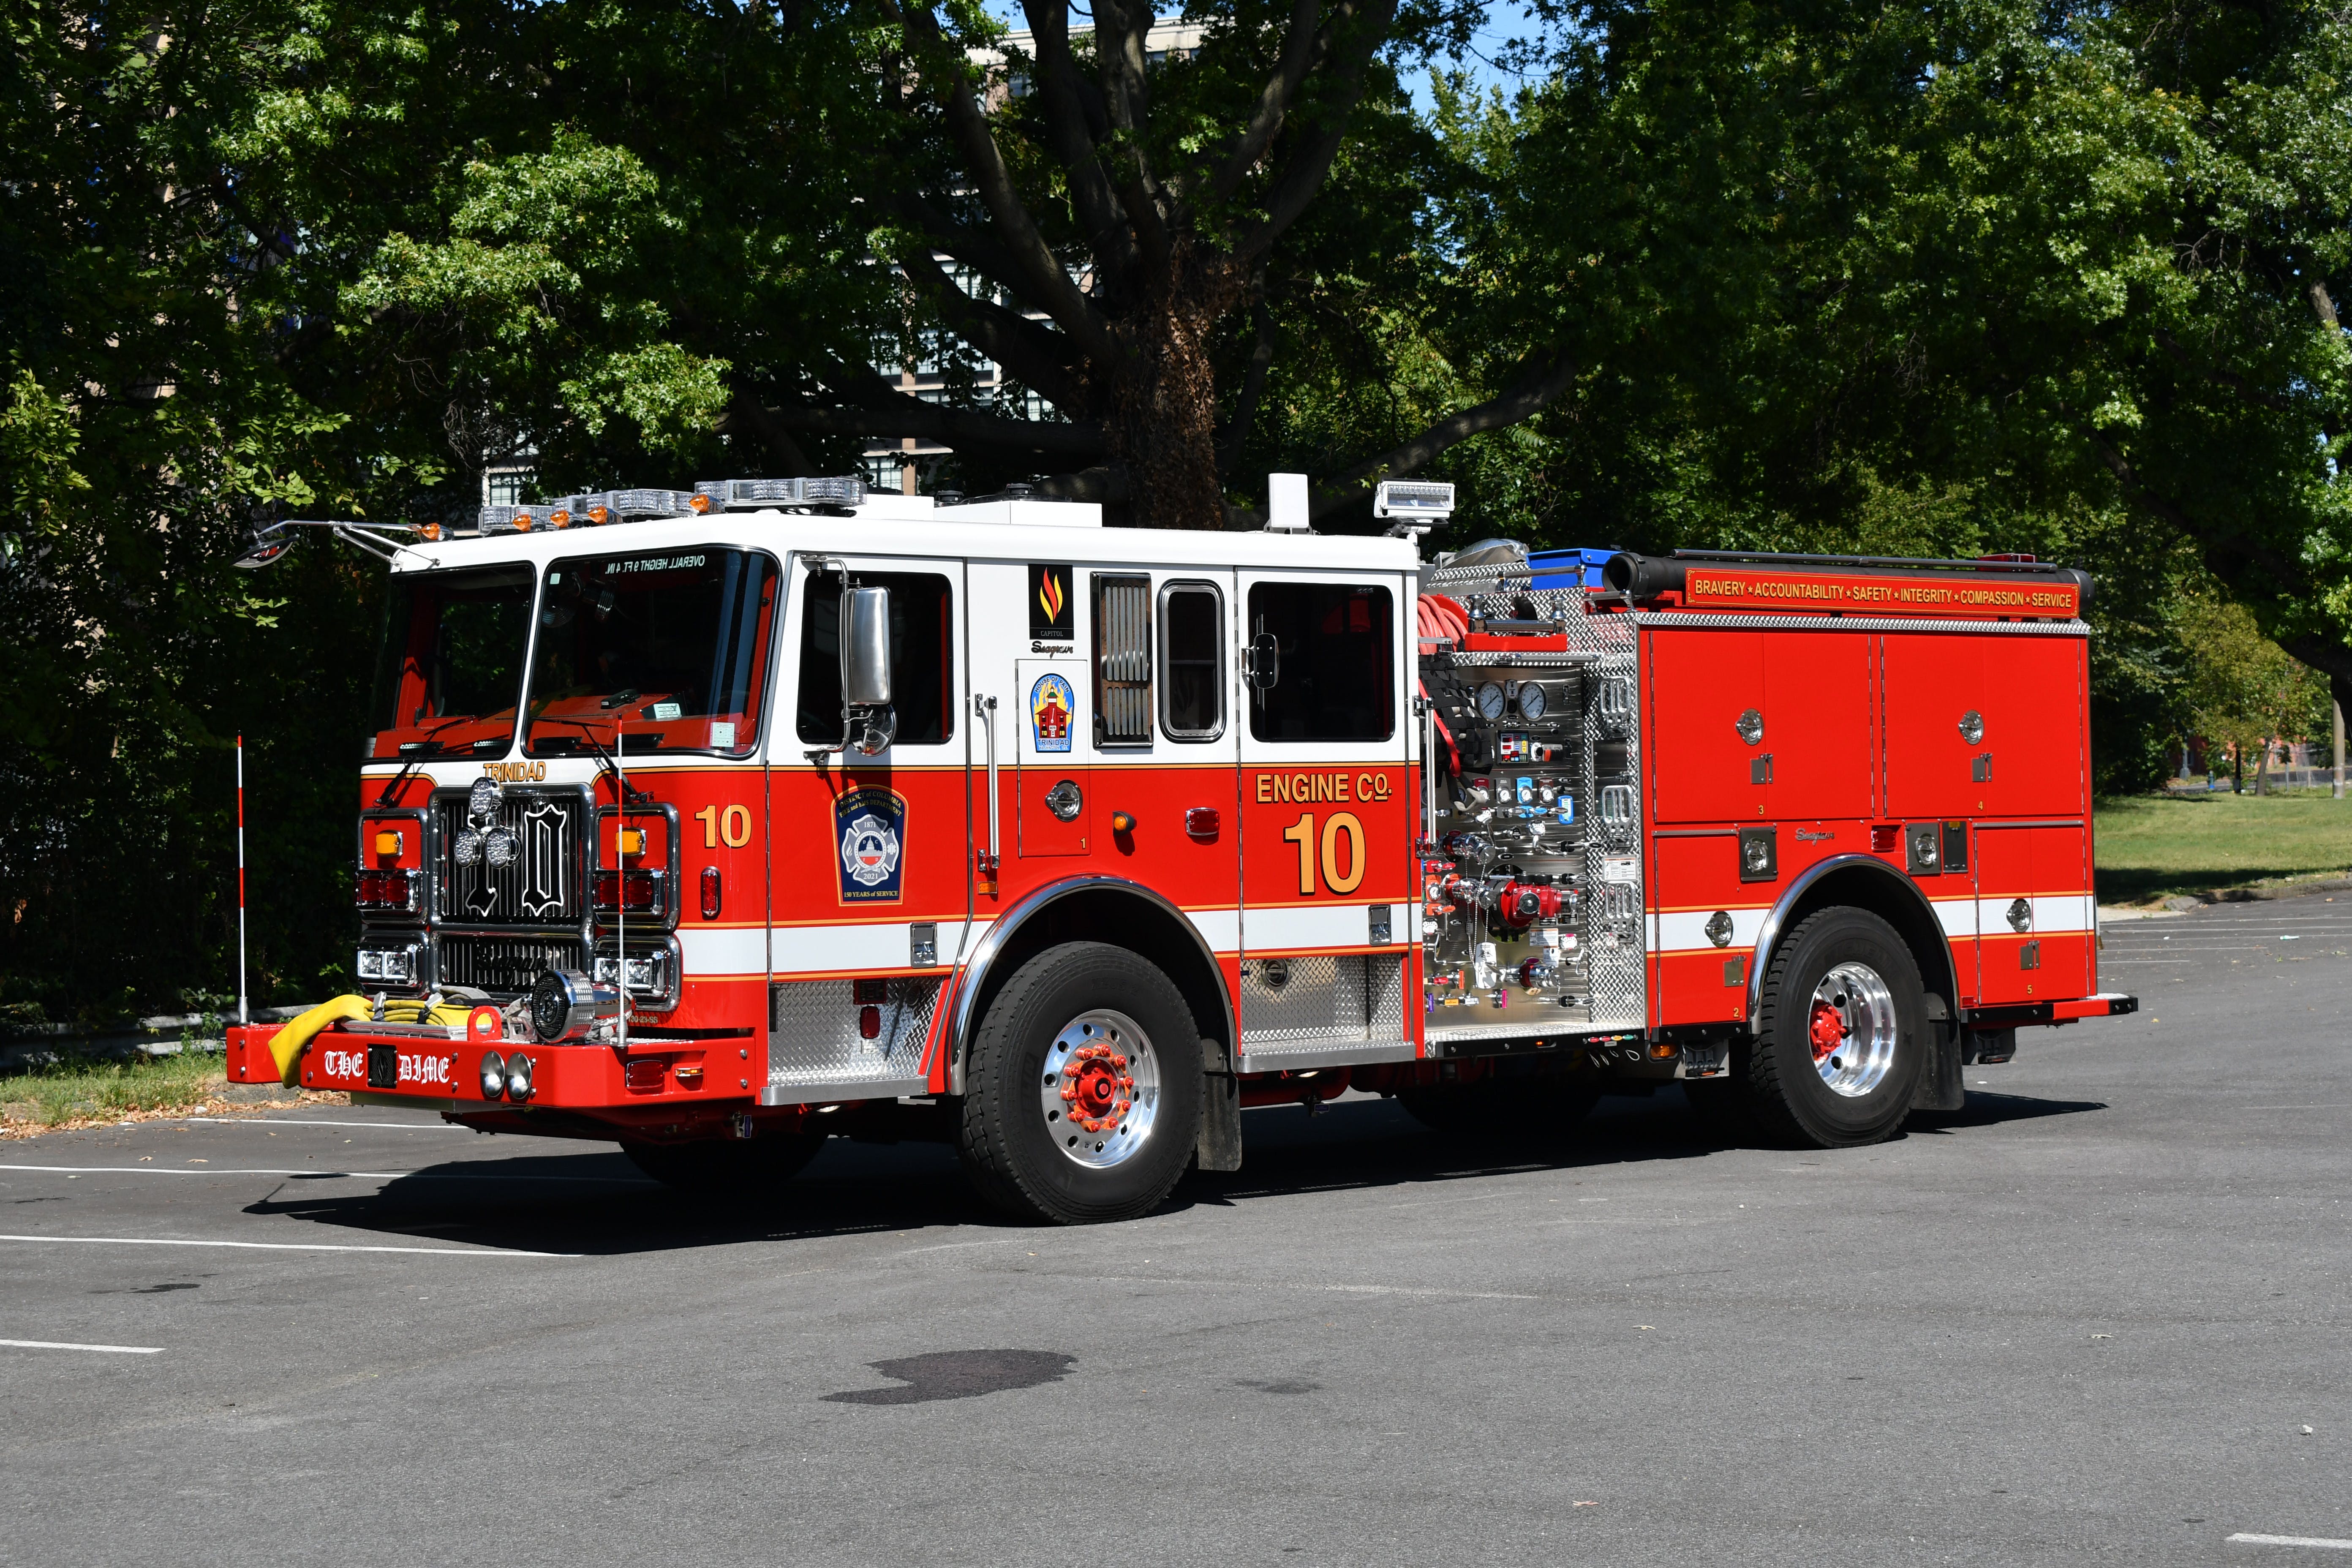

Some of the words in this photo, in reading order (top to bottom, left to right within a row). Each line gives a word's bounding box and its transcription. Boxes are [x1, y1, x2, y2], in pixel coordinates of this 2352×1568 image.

[1695, 580, 1745, 596] BRAVERY
[1754, 582, 1844, 599] ACCOUNTABILITY
[1853, 586, 1892, 601] SAFETY
[1901, 588, 1952, 603] INTEGRITY
[1960, 590, 2024, 605] COMPASSION
[2032, 592, 2072, 607] SERVICE
[1034, 677, 1050, 693] HOUSE
[1059, 680, 1070, 693] PAIN
[483, 761, 546, 783] TRINIDAD
[1256, 773, 1349, 803] ENGINE
[838, 808, 850, 818] FIRE
[850, 803, 858, 811] and
[870, 799, 902, 817] DEPARTMENT
[839, 792, 865, 808] DISTRICT
[873, 791, 902, 808] COLUMBIA
[1978, 801, 1983, 811] 4
[1759, 805, 1764, 815] 3
[694, 804, 752, 849] 10
[1283, 811, 1366, 896] 10
[2028, 985, 2033, 994] 5
[1733, 1007, 1739, 1018] 2
[324, 1051, 364, 1080] THE
[398, 1054, 450, 1084] DIME
